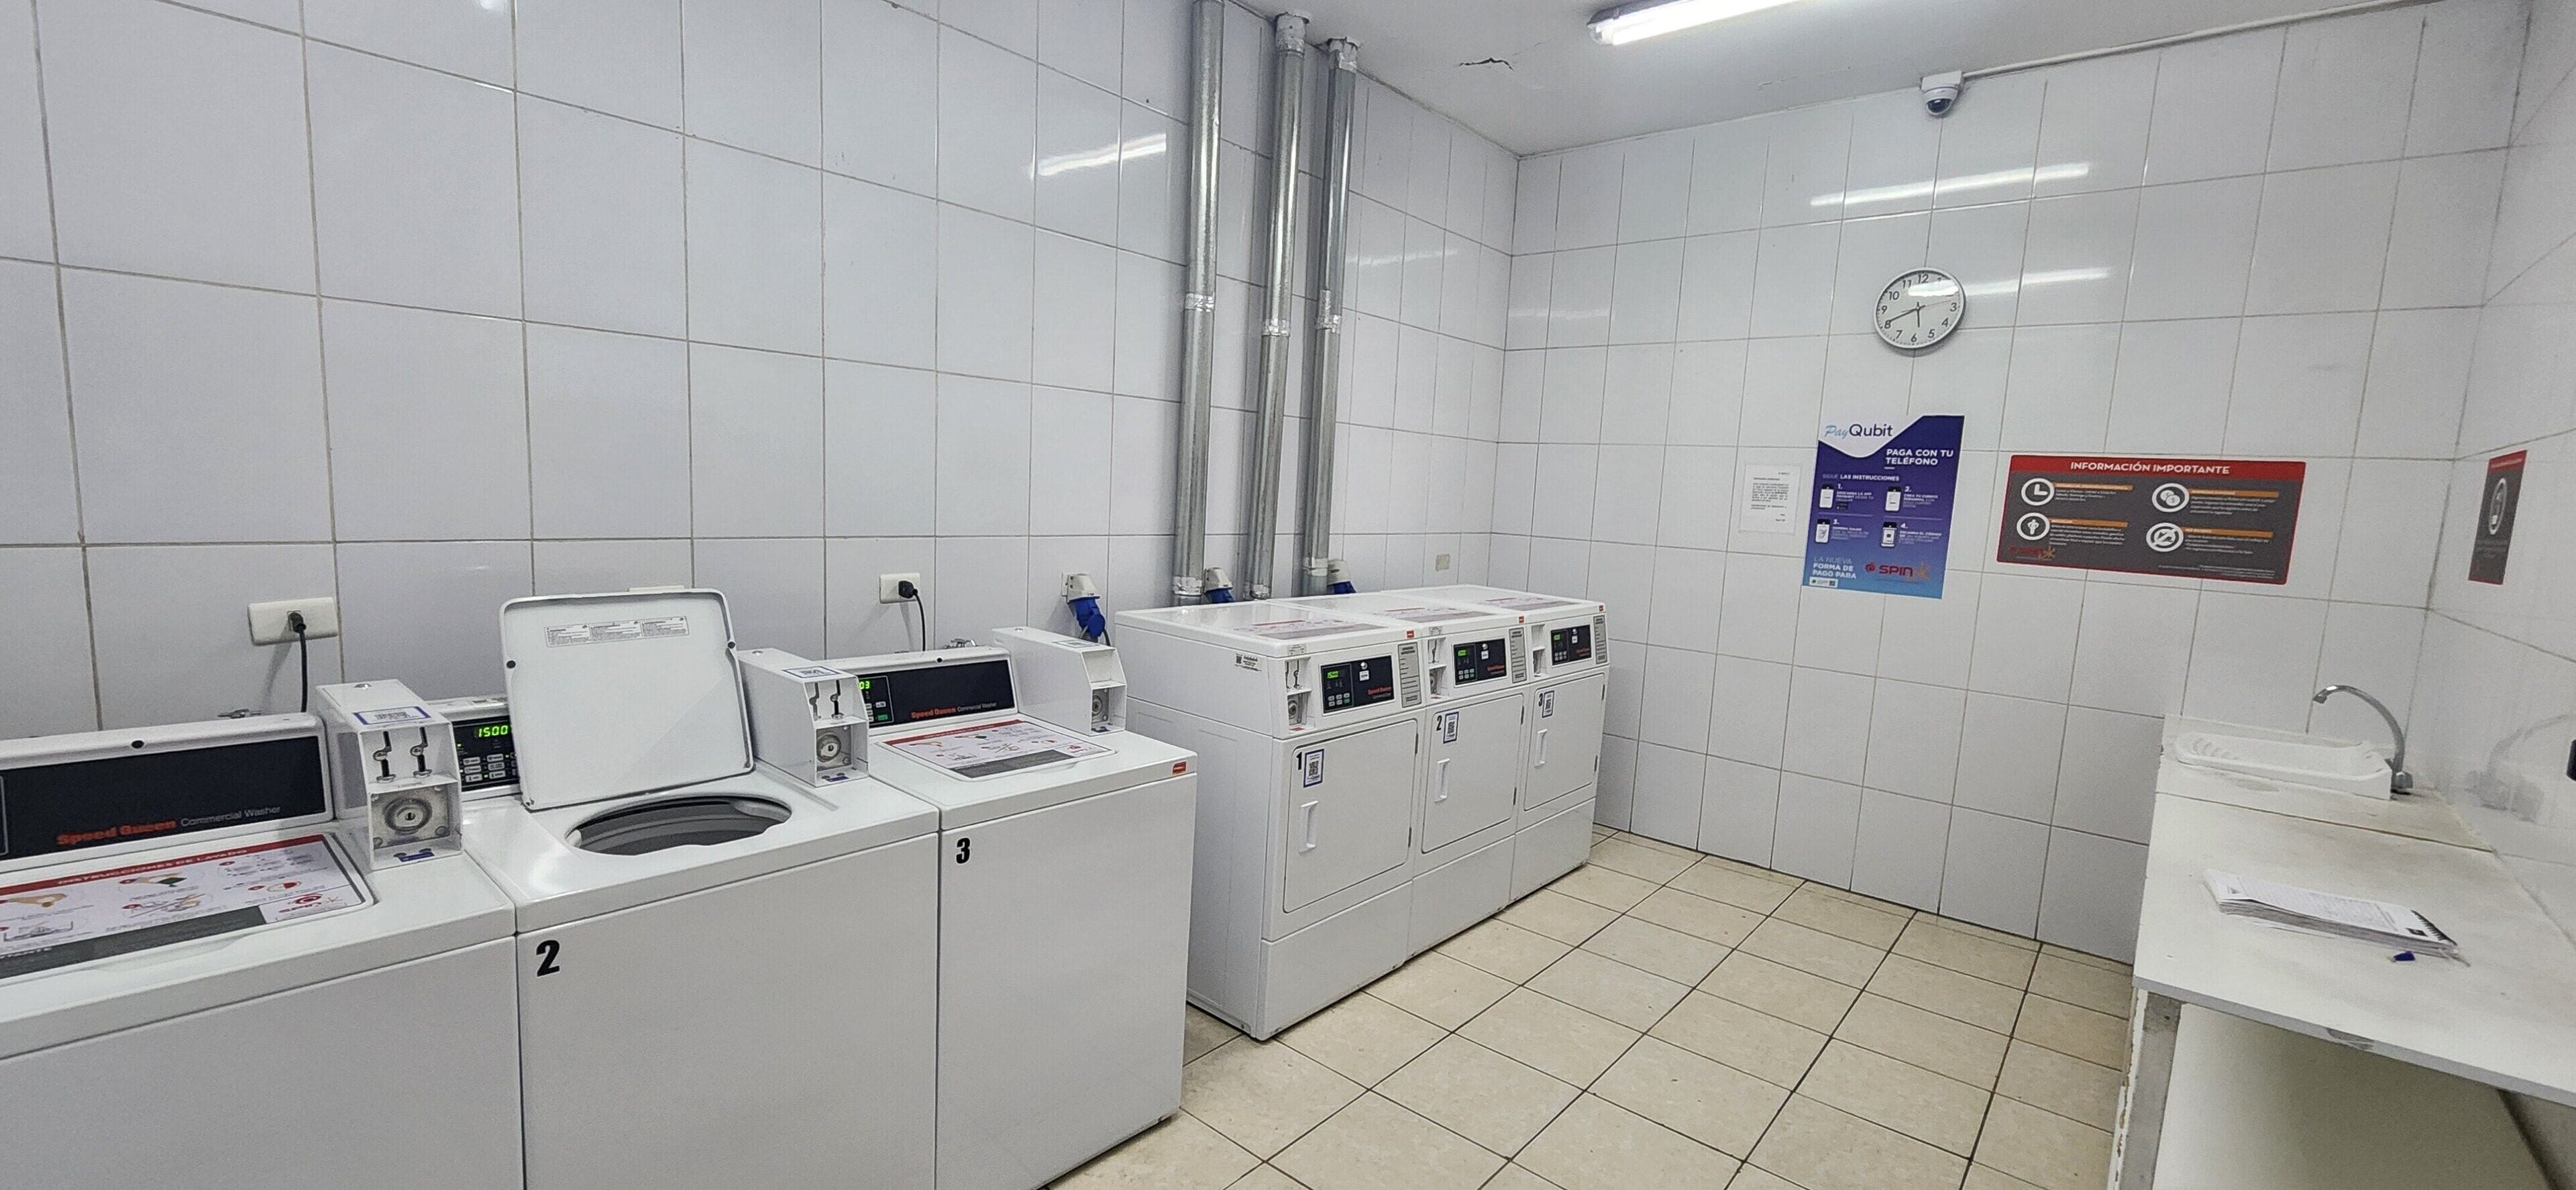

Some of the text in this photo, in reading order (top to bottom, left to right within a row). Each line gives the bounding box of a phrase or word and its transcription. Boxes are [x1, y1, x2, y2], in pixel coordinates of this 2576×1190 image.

[1902, 280, 1912, 288] 11
[1917, 274, 1929, 284] 12
[1888, 291, 1900, 301] 10
[1881, 305, 1888, 315] 9
[1950, 303, 1957, 312] 3
[1884, 319, 1892, 329] 8
[1941, 317, 1949, 327] 4
[1896, 330, 1903, 339] 7
[1911, 333, 1917, 343] 6
[1927, 329, 1935, 338] 5
[1885, 456, 1938, 466] TELÉFONO
[2071, 461, 2230, 474] INFORMACIÓN IMPORTANTE
[1825, 557, 1853, 565] NUEVA
[1835, 571, 1857, 579] PARA
[1538, 693, 1544, 707] 3
[911, 709, 933, 719] Speed
[934, 706, 956, 716] Queen
[1436, 715, 1442, 731] 2
[478, 725, 508, 738] 1500
[1296, 751, 1302, 770] 1
[180, 810, 242, 827] Commercial
[244, 806, 282, 818] Washer
[956, 837, 970, 864] 3
[536, 940, 559, 977] 2
